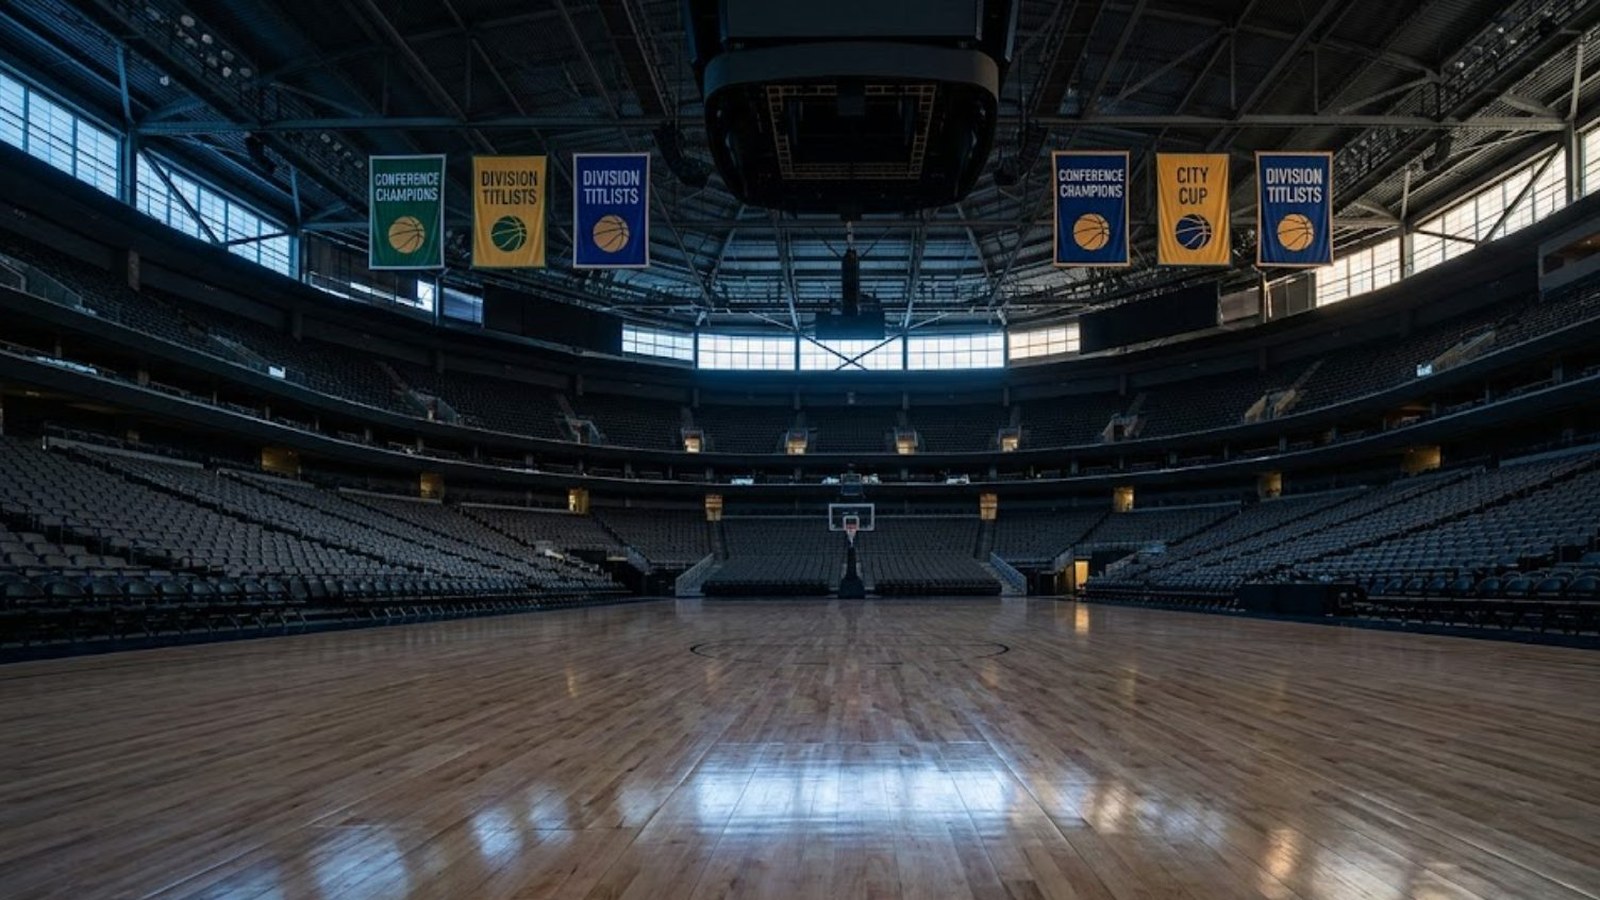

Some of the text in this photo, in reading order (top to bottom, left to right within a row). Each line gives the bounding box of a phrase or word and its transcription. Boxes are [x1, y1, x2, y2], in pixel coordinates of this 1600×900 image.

[375, 172, 439, 186] CONFERENCE
[481, 171, 537, 186] DIVISION
[583, 170, 639, 186] DIVISION
[1058, 168, 1124, 182] CONFERENCE
[1177, 167, 1209, 184] CITY
[1266, 168, 1322, 184] DIVISION
[376, 187, 438, 201] CHAMPIONS
[483, 189, 537, 204] TITLISTS
[584, 188, 639, 204] TITLISTS
[1060, 184, 1123, 198] CHAMPIONS
[1179, 187, 1208, 204] CUP
[1267, 186, 1322, 203] TITLISTS
